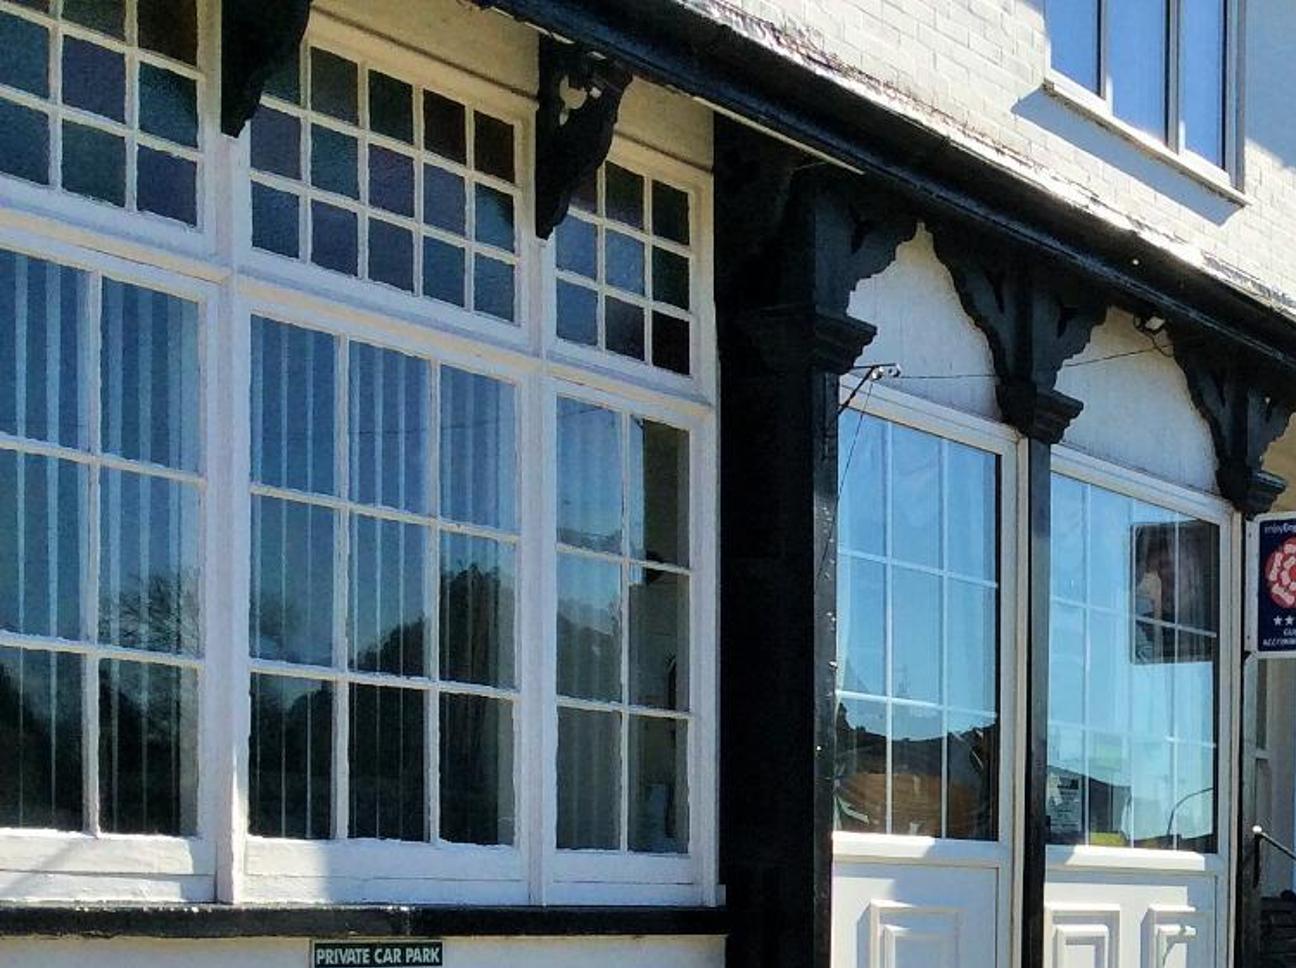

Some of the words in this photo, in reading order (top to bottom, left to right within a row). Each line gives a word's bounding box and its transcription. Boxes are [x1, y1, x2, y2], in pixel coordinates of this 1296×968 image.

[316, 948, 370, 965] PRIVATE
[374, 948, 402, 963] CAR
[405, 947, 440, 963] PARK
